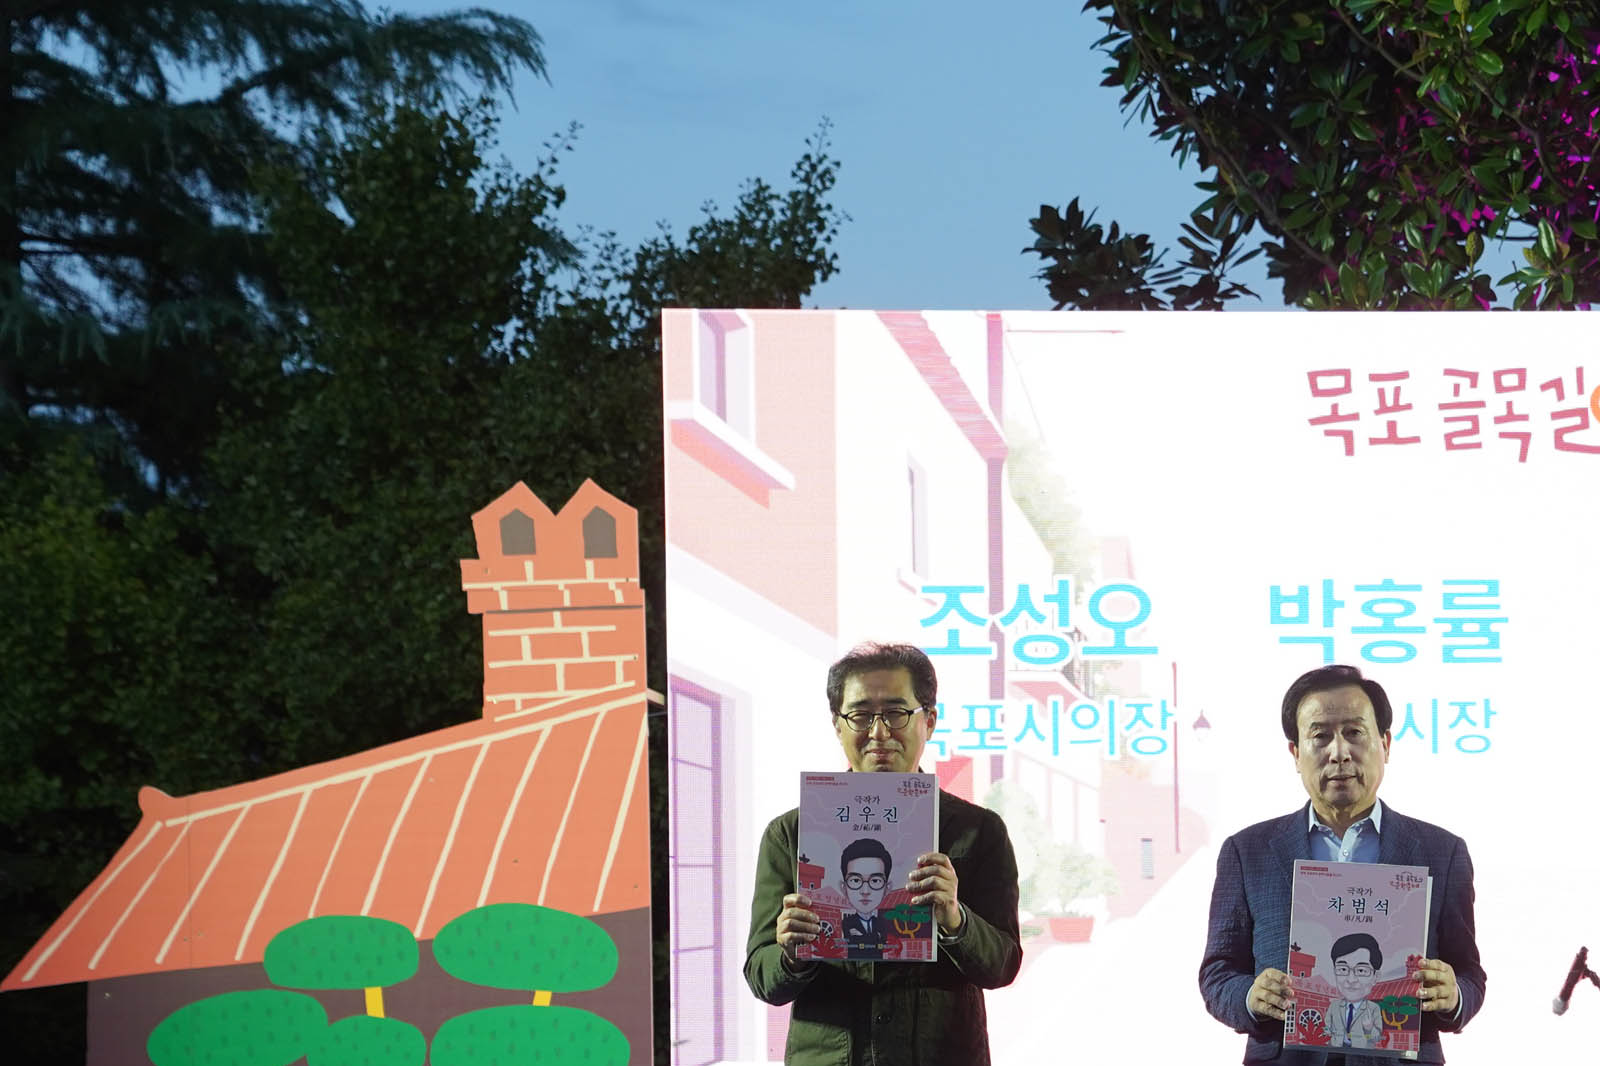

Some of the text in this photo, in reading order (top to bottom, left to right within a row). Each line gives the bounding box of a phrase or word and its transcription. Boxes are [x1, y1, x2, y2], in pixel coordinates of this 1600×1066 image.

[1307, 368, 1421, 457] 목포
[919, 579, 1159, 662] 조성오
[1269, 577, 1509, 664] 박홍률
[836, 805, 898, 823] 김우진
[1328, 896, 1389, 916] 차범석
[1346, 886, 1373, 897] 극작가
